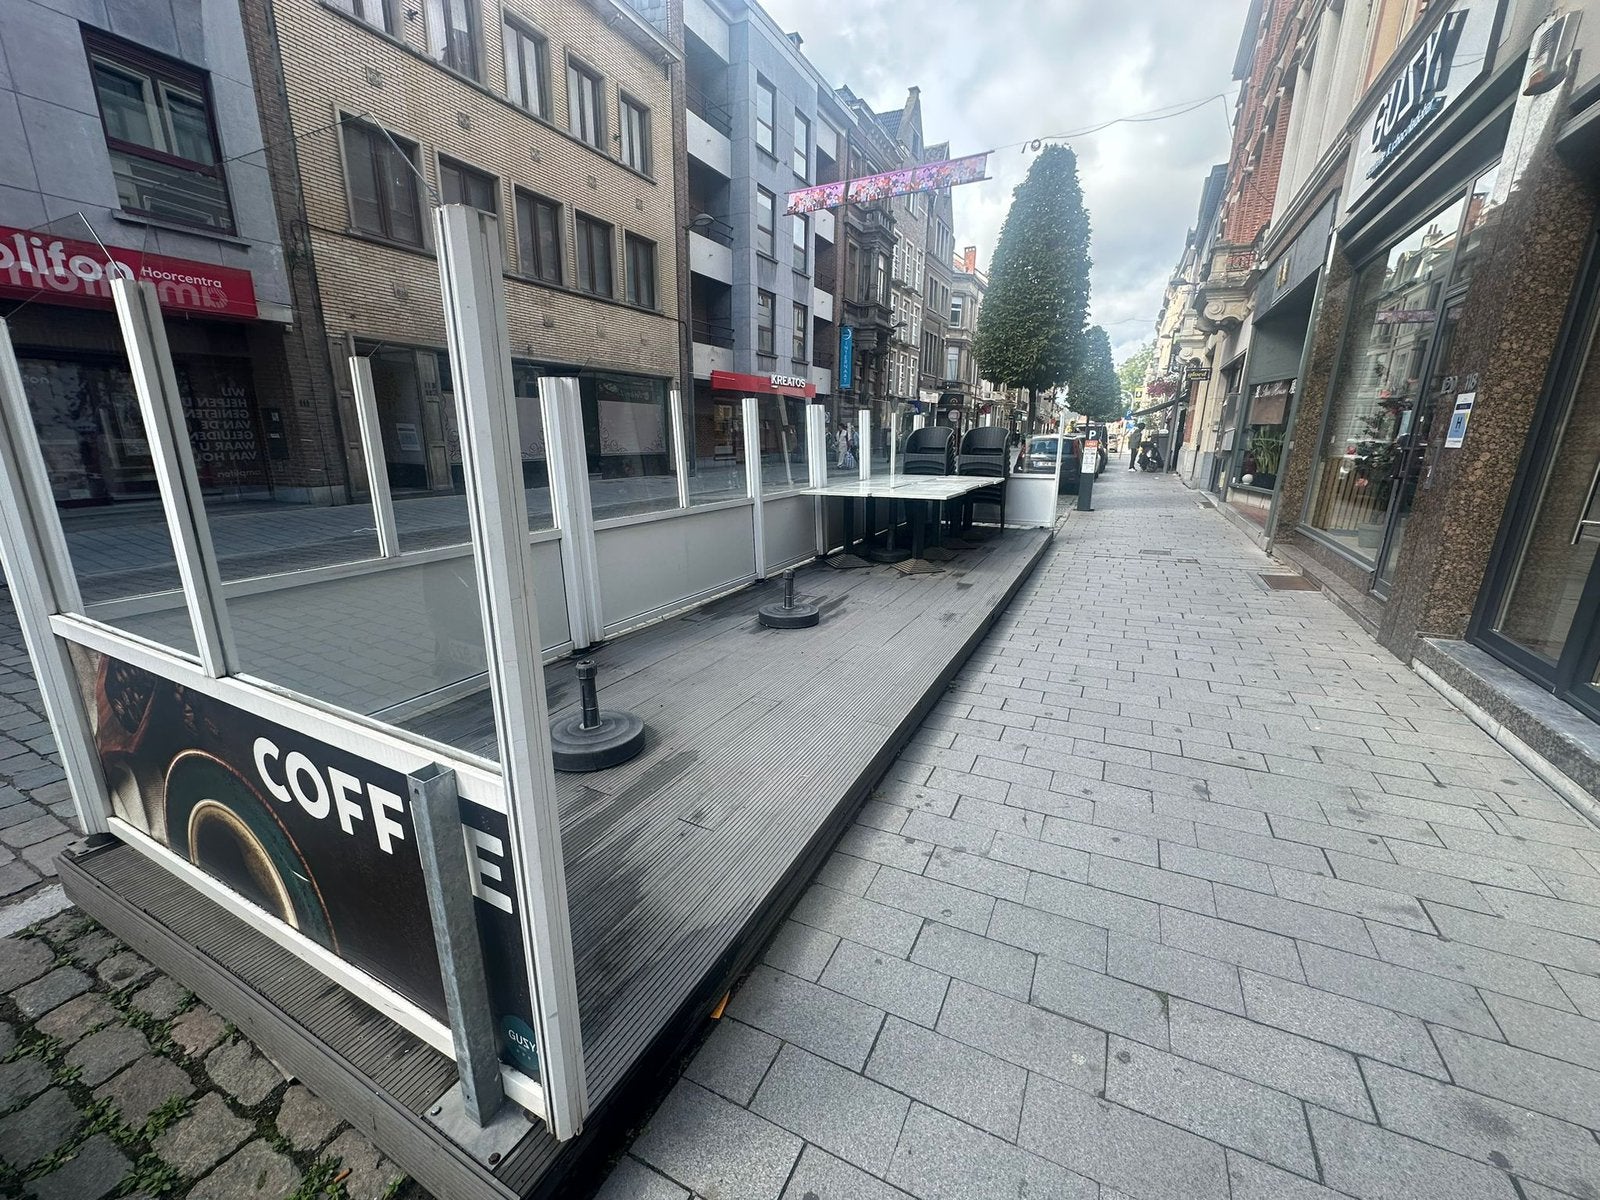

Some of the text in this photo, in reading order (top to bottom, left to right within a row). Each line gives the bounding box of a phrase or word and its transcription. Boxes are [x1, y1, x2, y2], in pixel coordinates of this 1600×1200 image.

[141, 266, 222, 288] Hoorcentra
[771, 374, 806, 388] KREATOS
[1089, 429, 1097, 440] P
[253, 737, 513, 914] COFFE
[508, 1029, 536, 1053] GUSY
